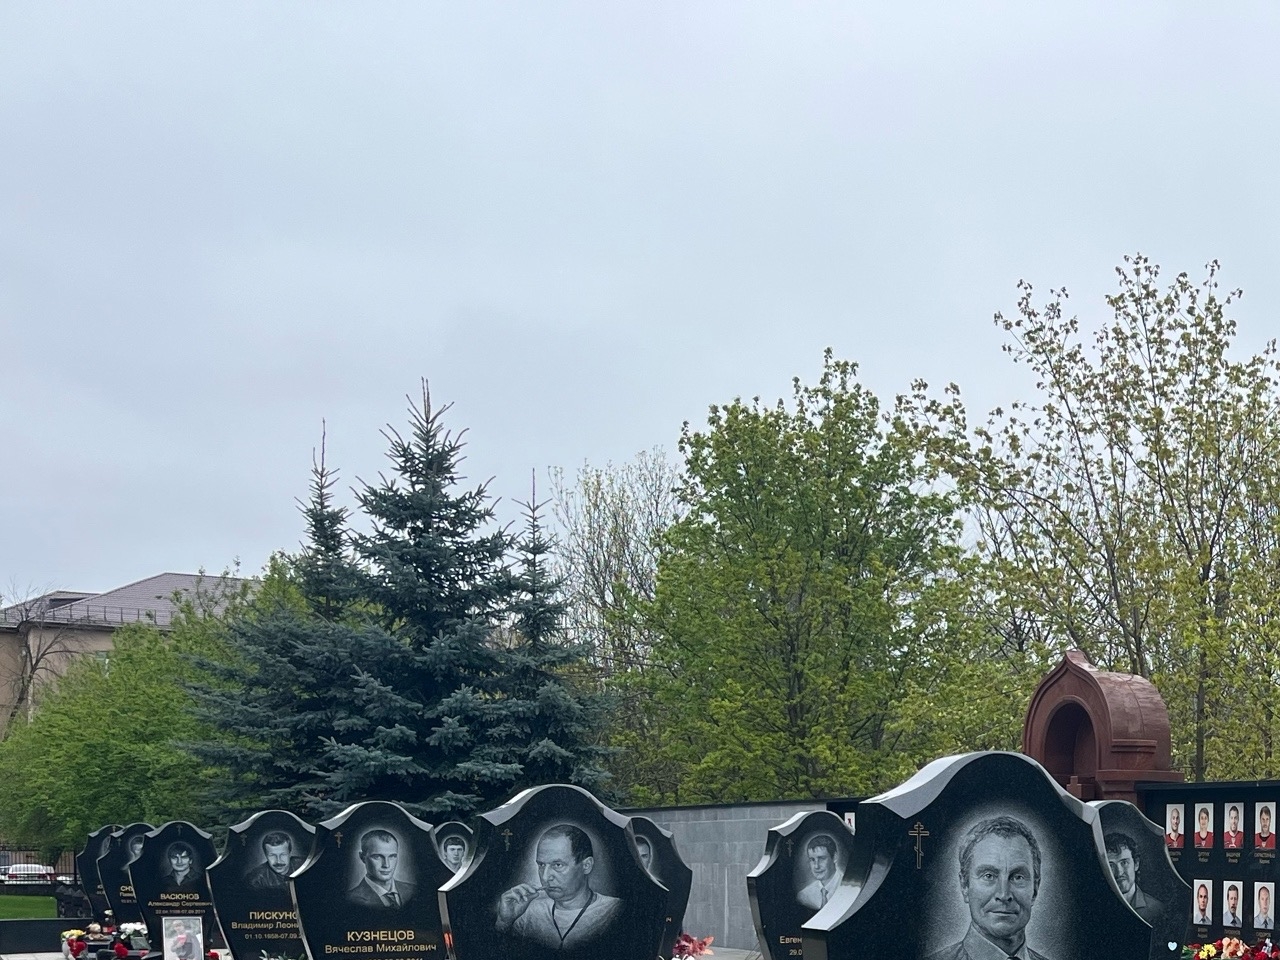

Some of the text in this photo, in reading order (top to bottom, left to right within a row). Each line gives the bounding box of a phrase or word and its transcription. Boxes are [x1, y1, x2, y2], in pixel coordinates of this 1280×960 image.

[231, 921, 274, 930] Владимир
[347, 930, 415, 942] КУЗНЕЦОВ
[324, 942, 437, 954] Вячеслав Михайлович
